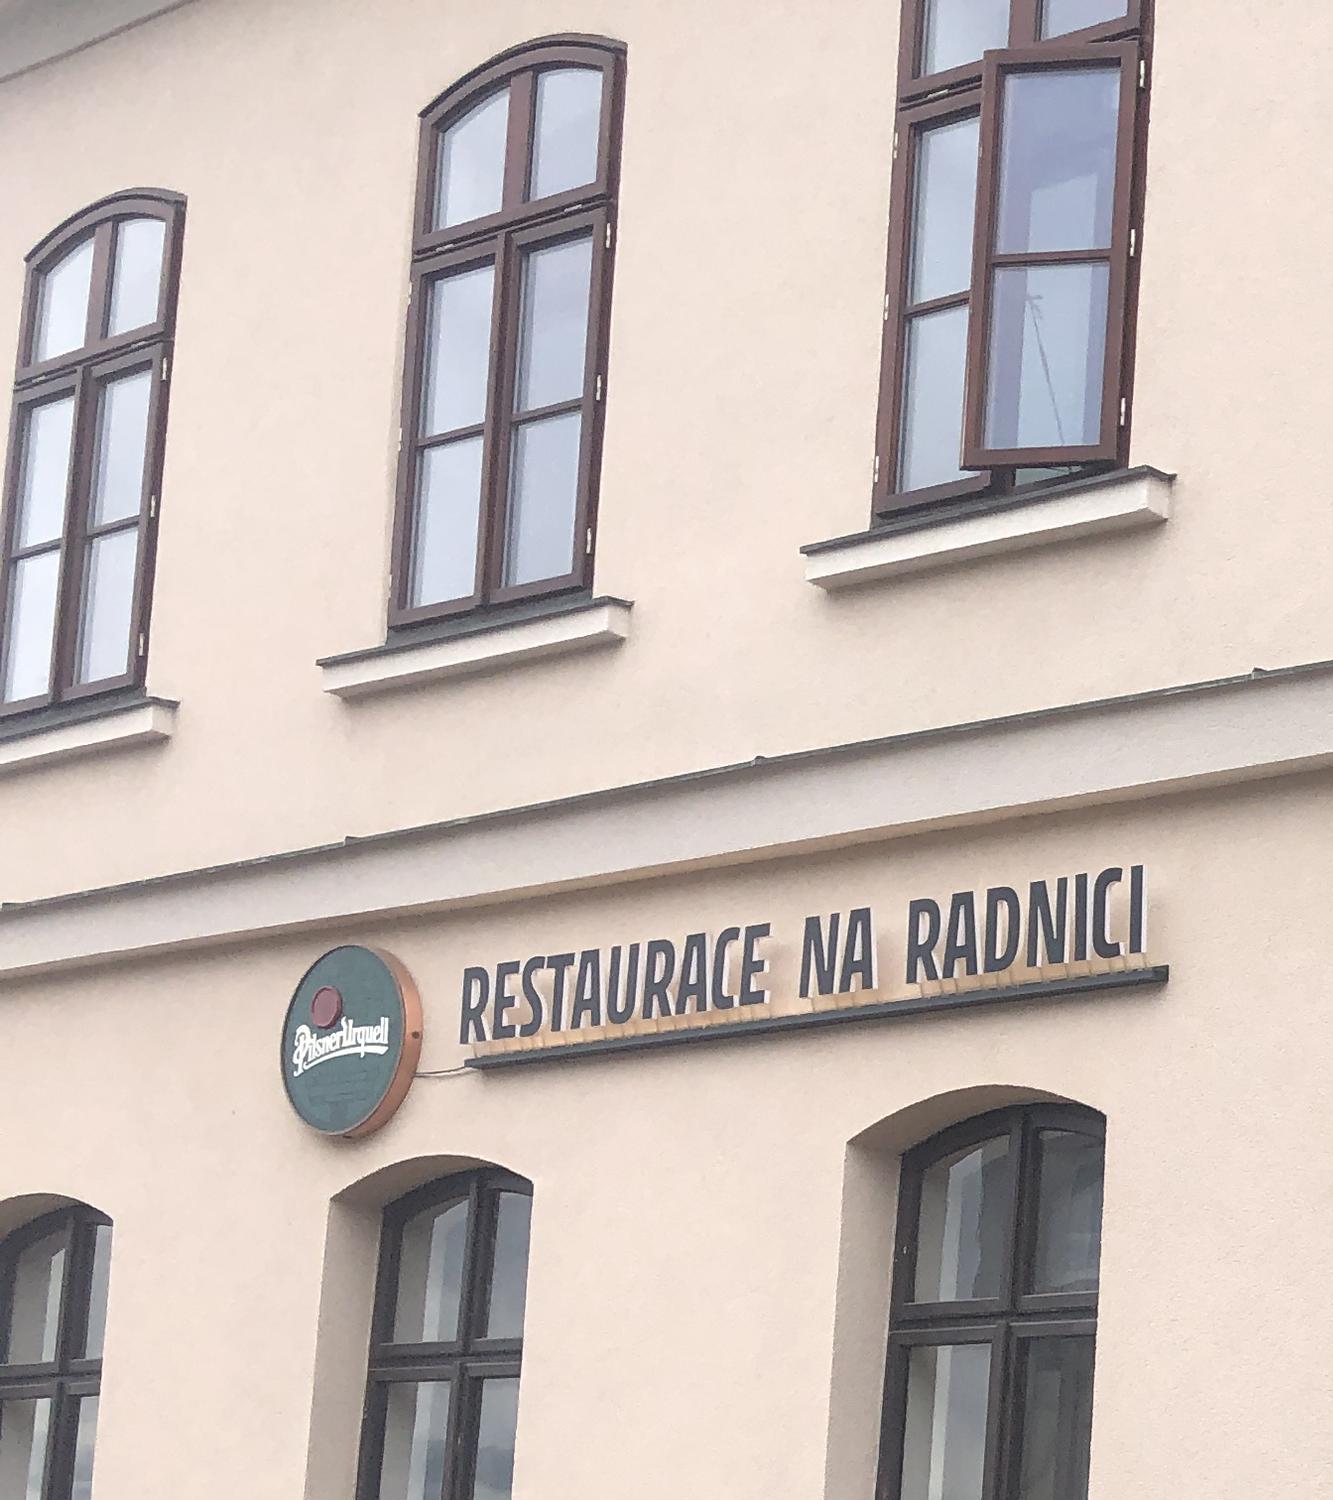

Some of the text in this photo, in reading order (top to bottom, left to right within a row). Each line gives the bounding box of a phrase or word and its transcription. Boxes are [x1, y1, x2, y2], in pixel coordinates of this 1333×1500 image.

[460, 865, 1148, 1044] RESTAURACE NA RADNICI
[293, 1016, 389, 1077] Pilsner Urquell
